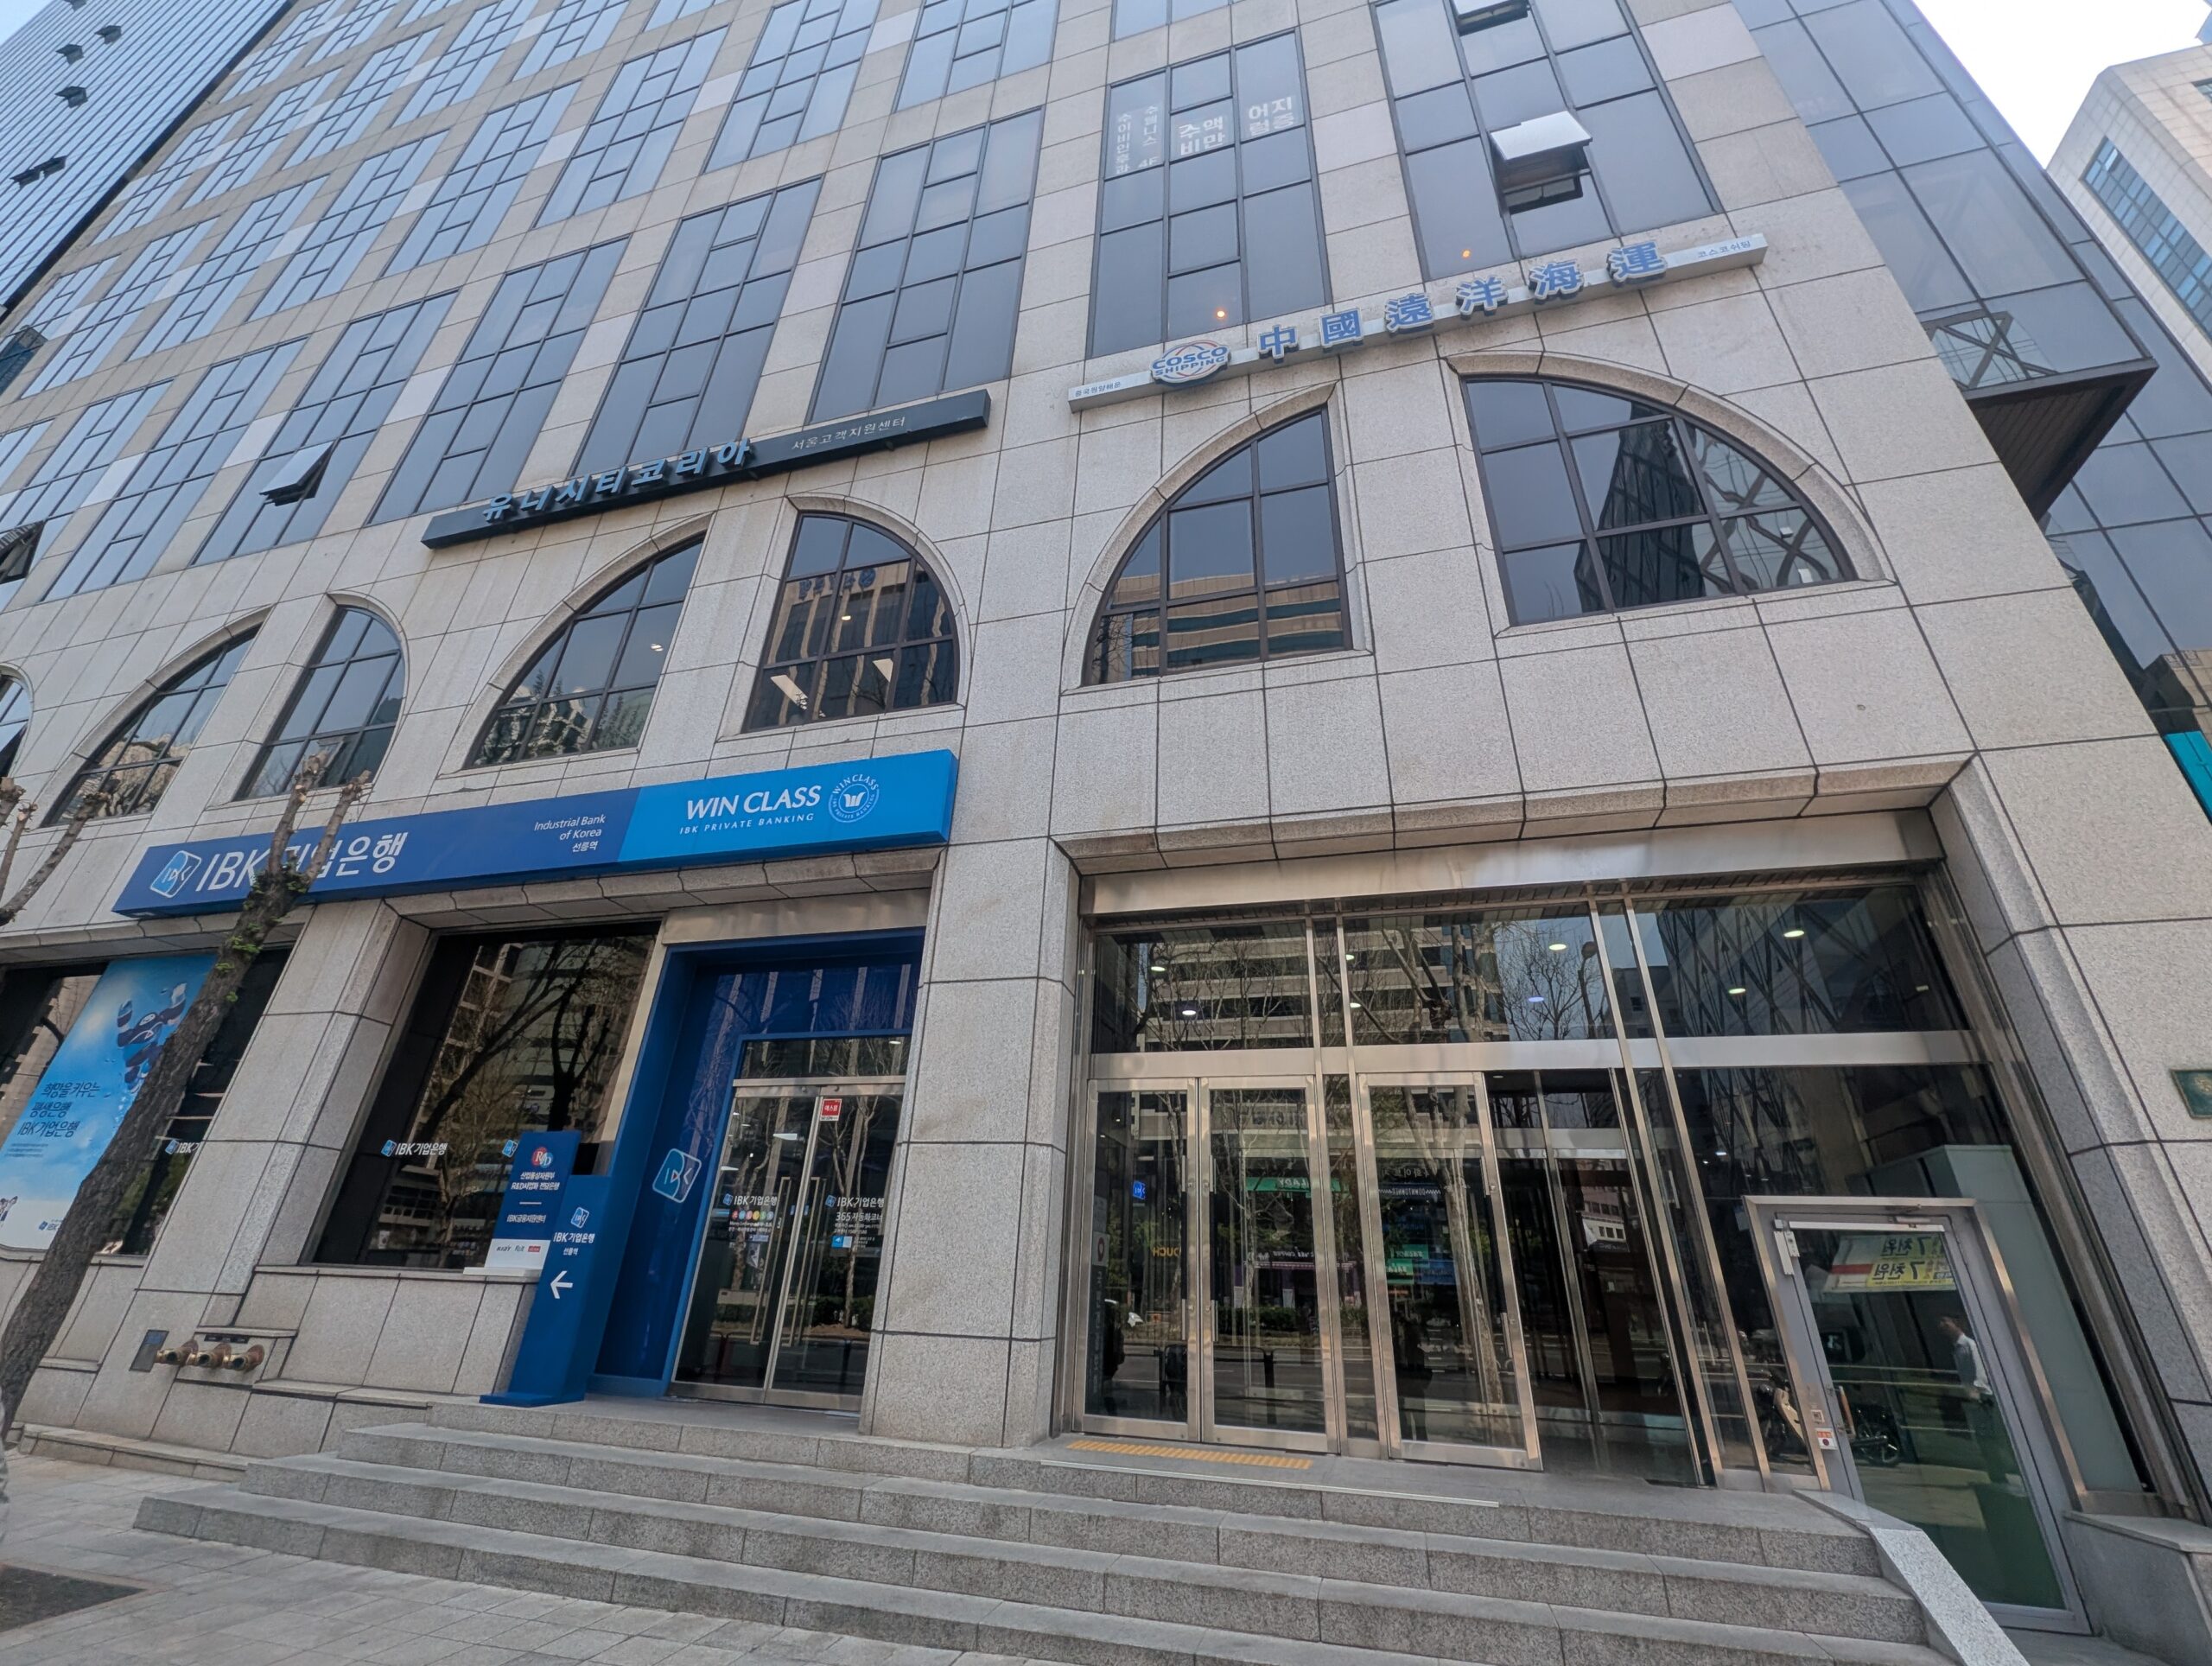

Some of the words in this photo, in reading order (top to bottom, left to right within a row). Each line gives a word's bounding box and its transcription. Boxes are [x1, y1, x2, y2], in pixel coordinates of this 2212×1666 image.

[1180, 132, 1225, 156] 비만
[1260, 240, 1665, 359] 中國遠洋海運
[1152, 347, 1227, 370] COSCO
[1155, 356, 1225, 376] SHIPPING
[791, 416, 906, 451] 서울고객지원센터
[483, 437, 752, 523] 유니시티코리아
[687, 794, 740, 820] WIN
[743, 785, 822, 814] CLASS
[534, 817, 580, 831] Industrial
[581, 813, 607, 826] Bank
[679, 825, 699, 835] IBK
[703, 819, 753, 832] PRIVATE
[758, 812, 814, 826] BANKING
[559, 830, 572, 841] of
[573, 829, 602, 839] Korea
[572, 840, 598, 853] 선릉역
